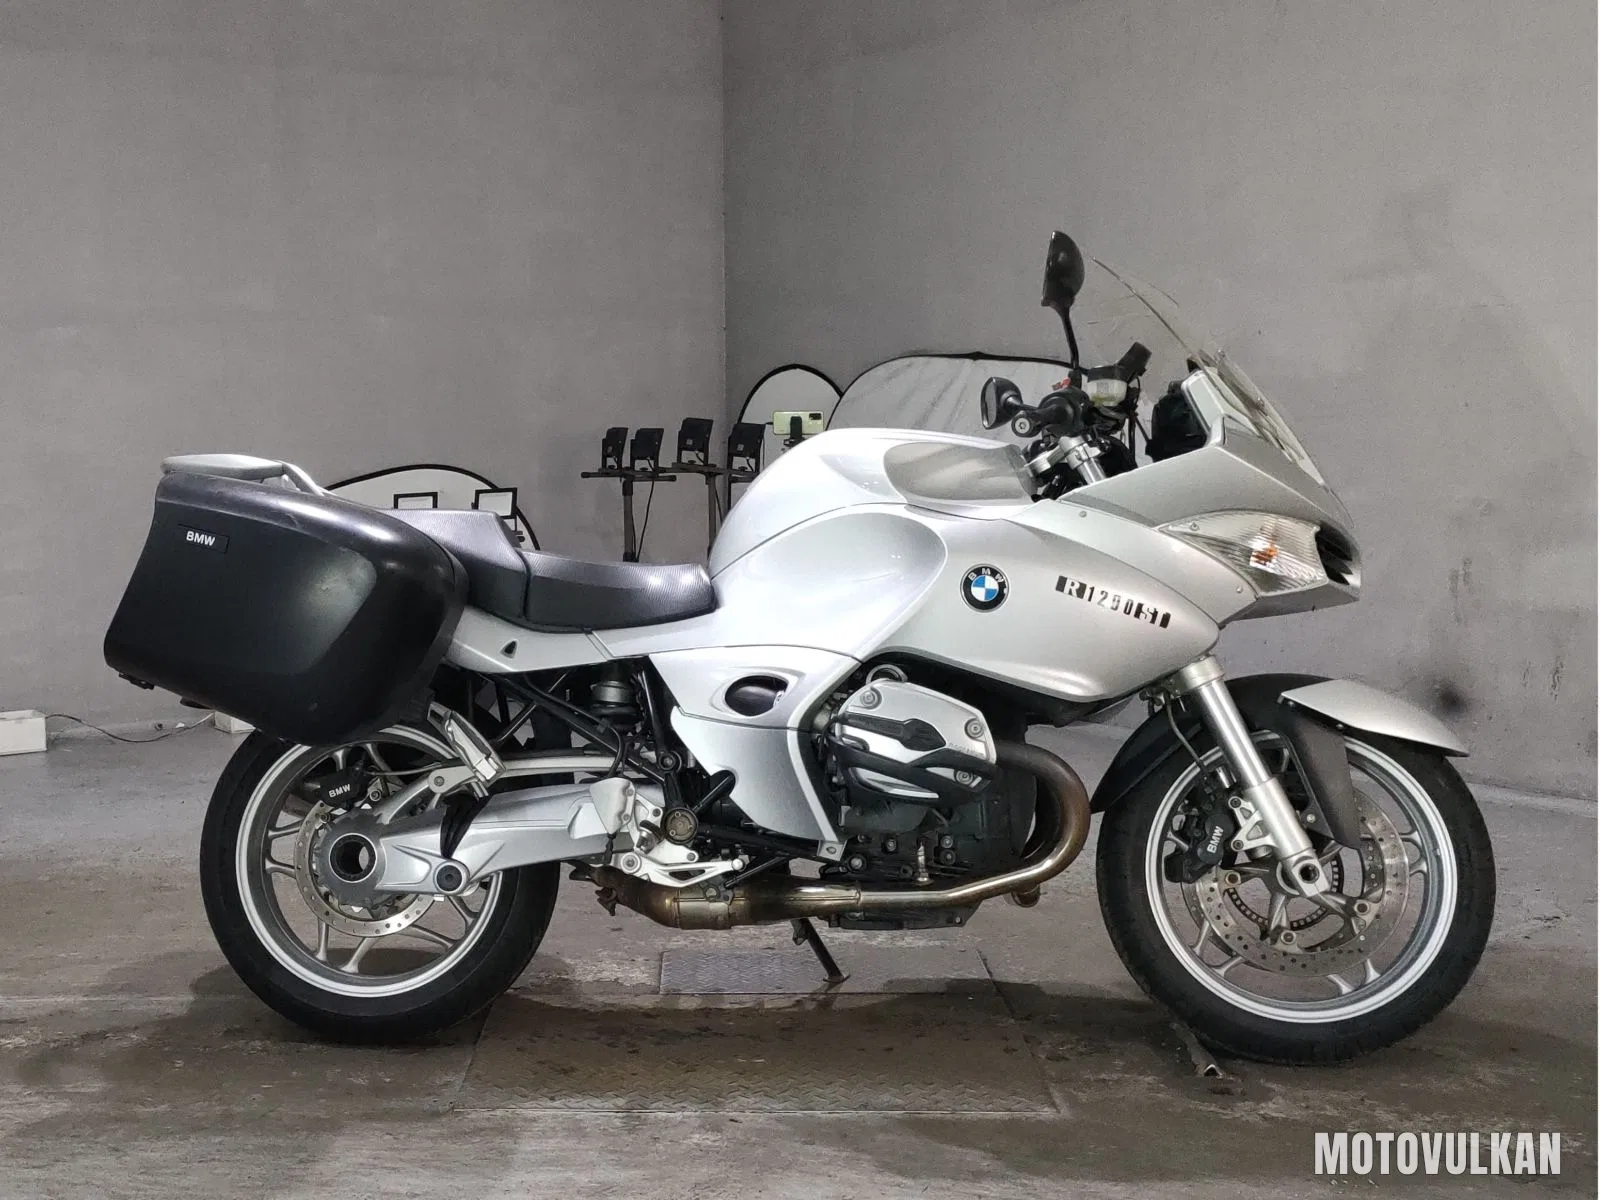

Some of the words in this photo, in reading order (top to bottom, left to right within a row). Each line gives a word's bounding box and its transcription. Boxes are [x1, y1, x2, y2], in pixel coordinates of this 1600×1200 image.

[184, 530, 216, 546] BMW
[968, 567, 1005, 583] BMW
[328, 783, 351, 798] BMW
[1206, 825, 1224, 854] BMW
